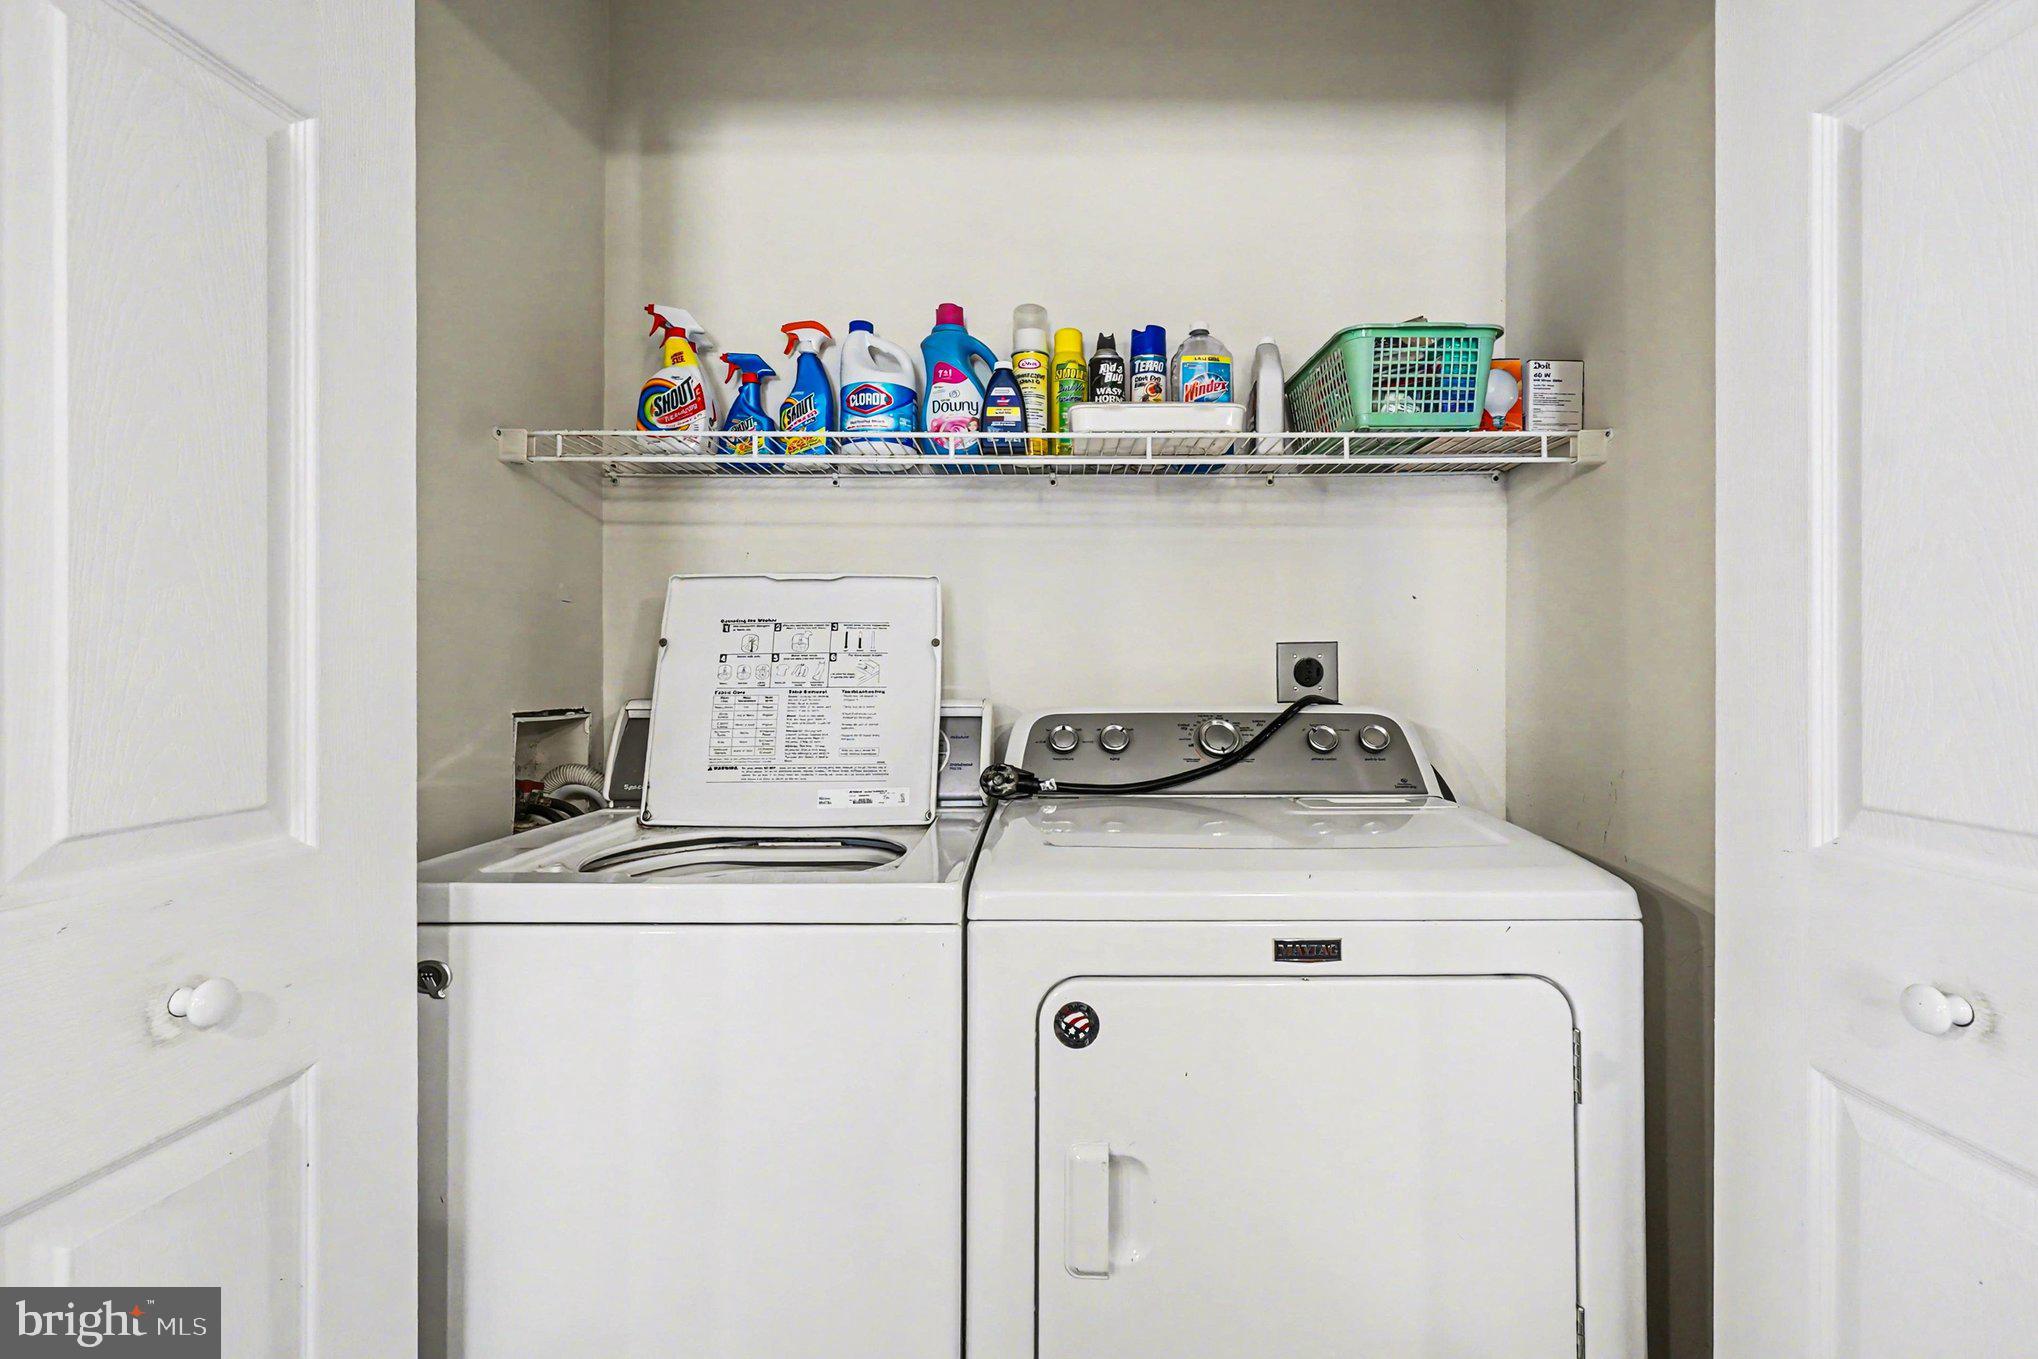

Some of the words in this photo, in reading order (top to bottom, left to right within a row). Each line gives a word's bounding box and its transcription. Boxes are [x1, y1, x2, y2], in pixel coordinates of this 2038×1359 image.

[1133, 360, 1164, 373] TERRO
[653, 376, 695, 417] SHOUT
[1183, 380, 1228, 403] Windex
[849, 392, 887, 407] CLOROX
[932, 400, 979, 416] Downy
[1278, 944, 1338, 957] MAYTAG
